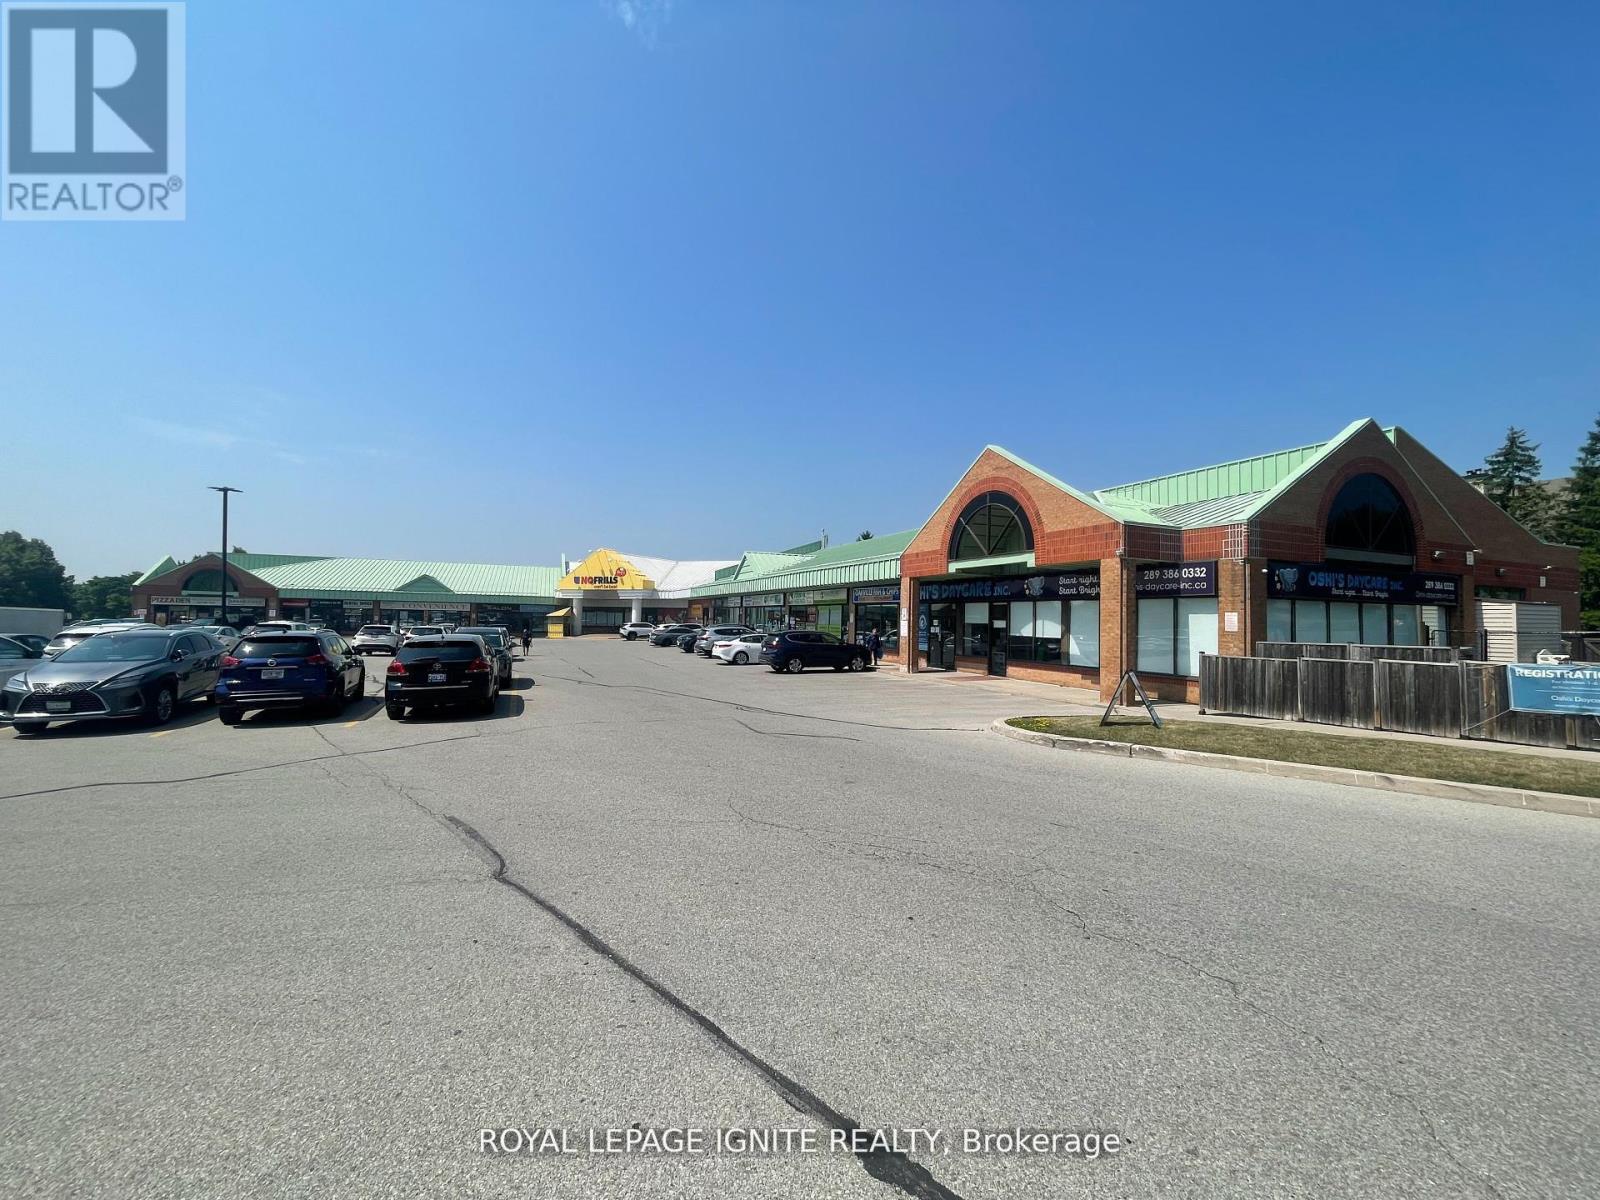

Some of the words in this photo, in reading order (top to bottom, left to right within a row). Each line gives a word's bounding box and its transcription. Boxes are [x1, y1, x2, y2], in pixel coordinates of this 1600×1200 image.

[1144, 570, 1160, 580] 289
[1162, 569, 1179, 579] 386
[1182, 567, 1207, 578] 0332
[1059, 576, 1077, 585] Start
[941, 581, 992, 599] DAYCARE
[1059, 586, 1077, 595] Start
